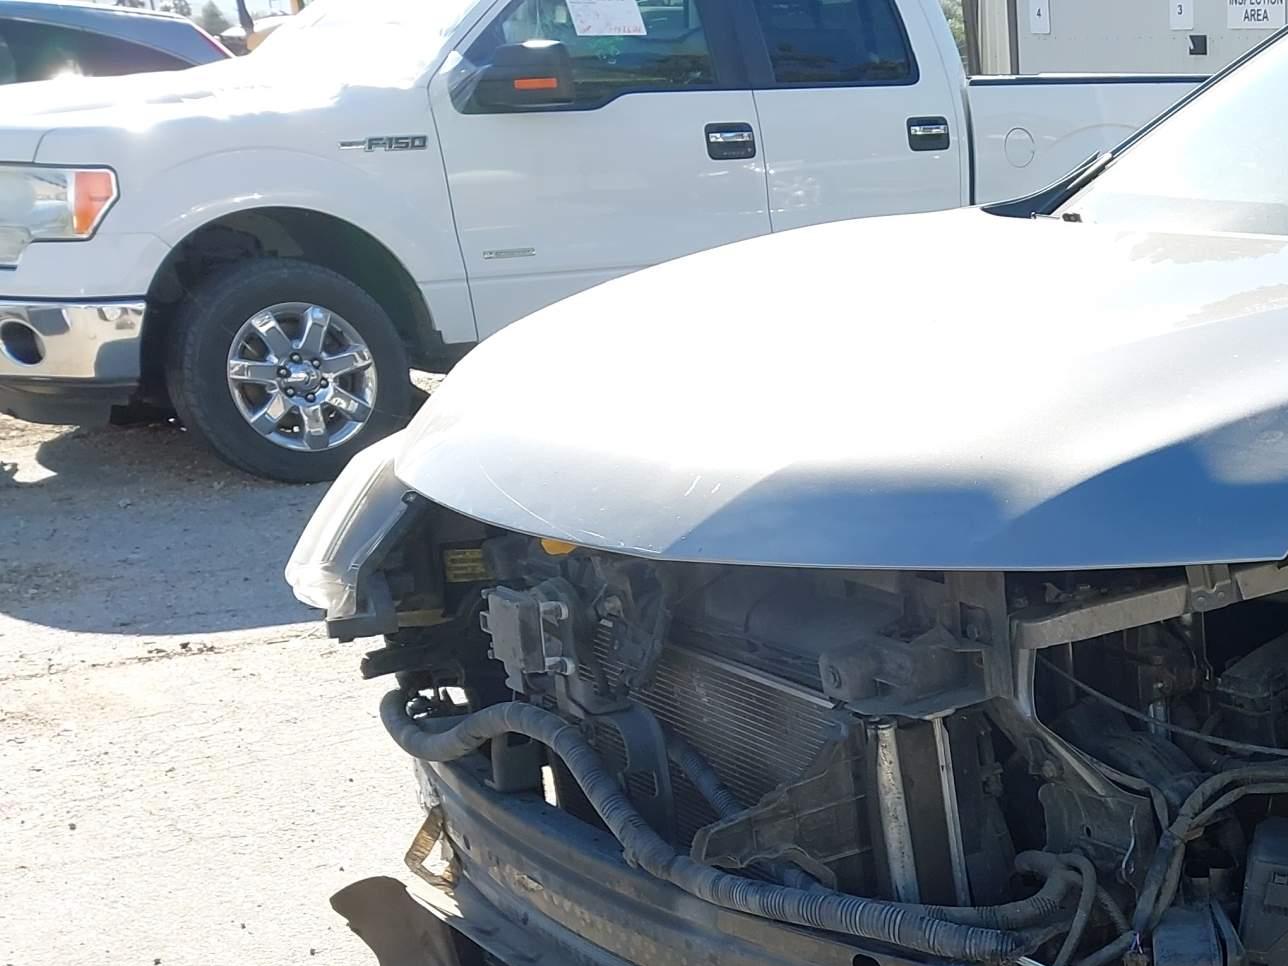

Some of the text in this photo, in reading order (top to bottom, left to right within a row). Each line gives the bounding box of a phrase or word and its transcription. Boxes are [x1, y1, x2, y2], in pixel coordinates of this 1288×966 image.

[1036, 8, 1042, 17] 4
[1177, 4, 1183, 15] 3
[1243, 9, 1270, 21] AREA
